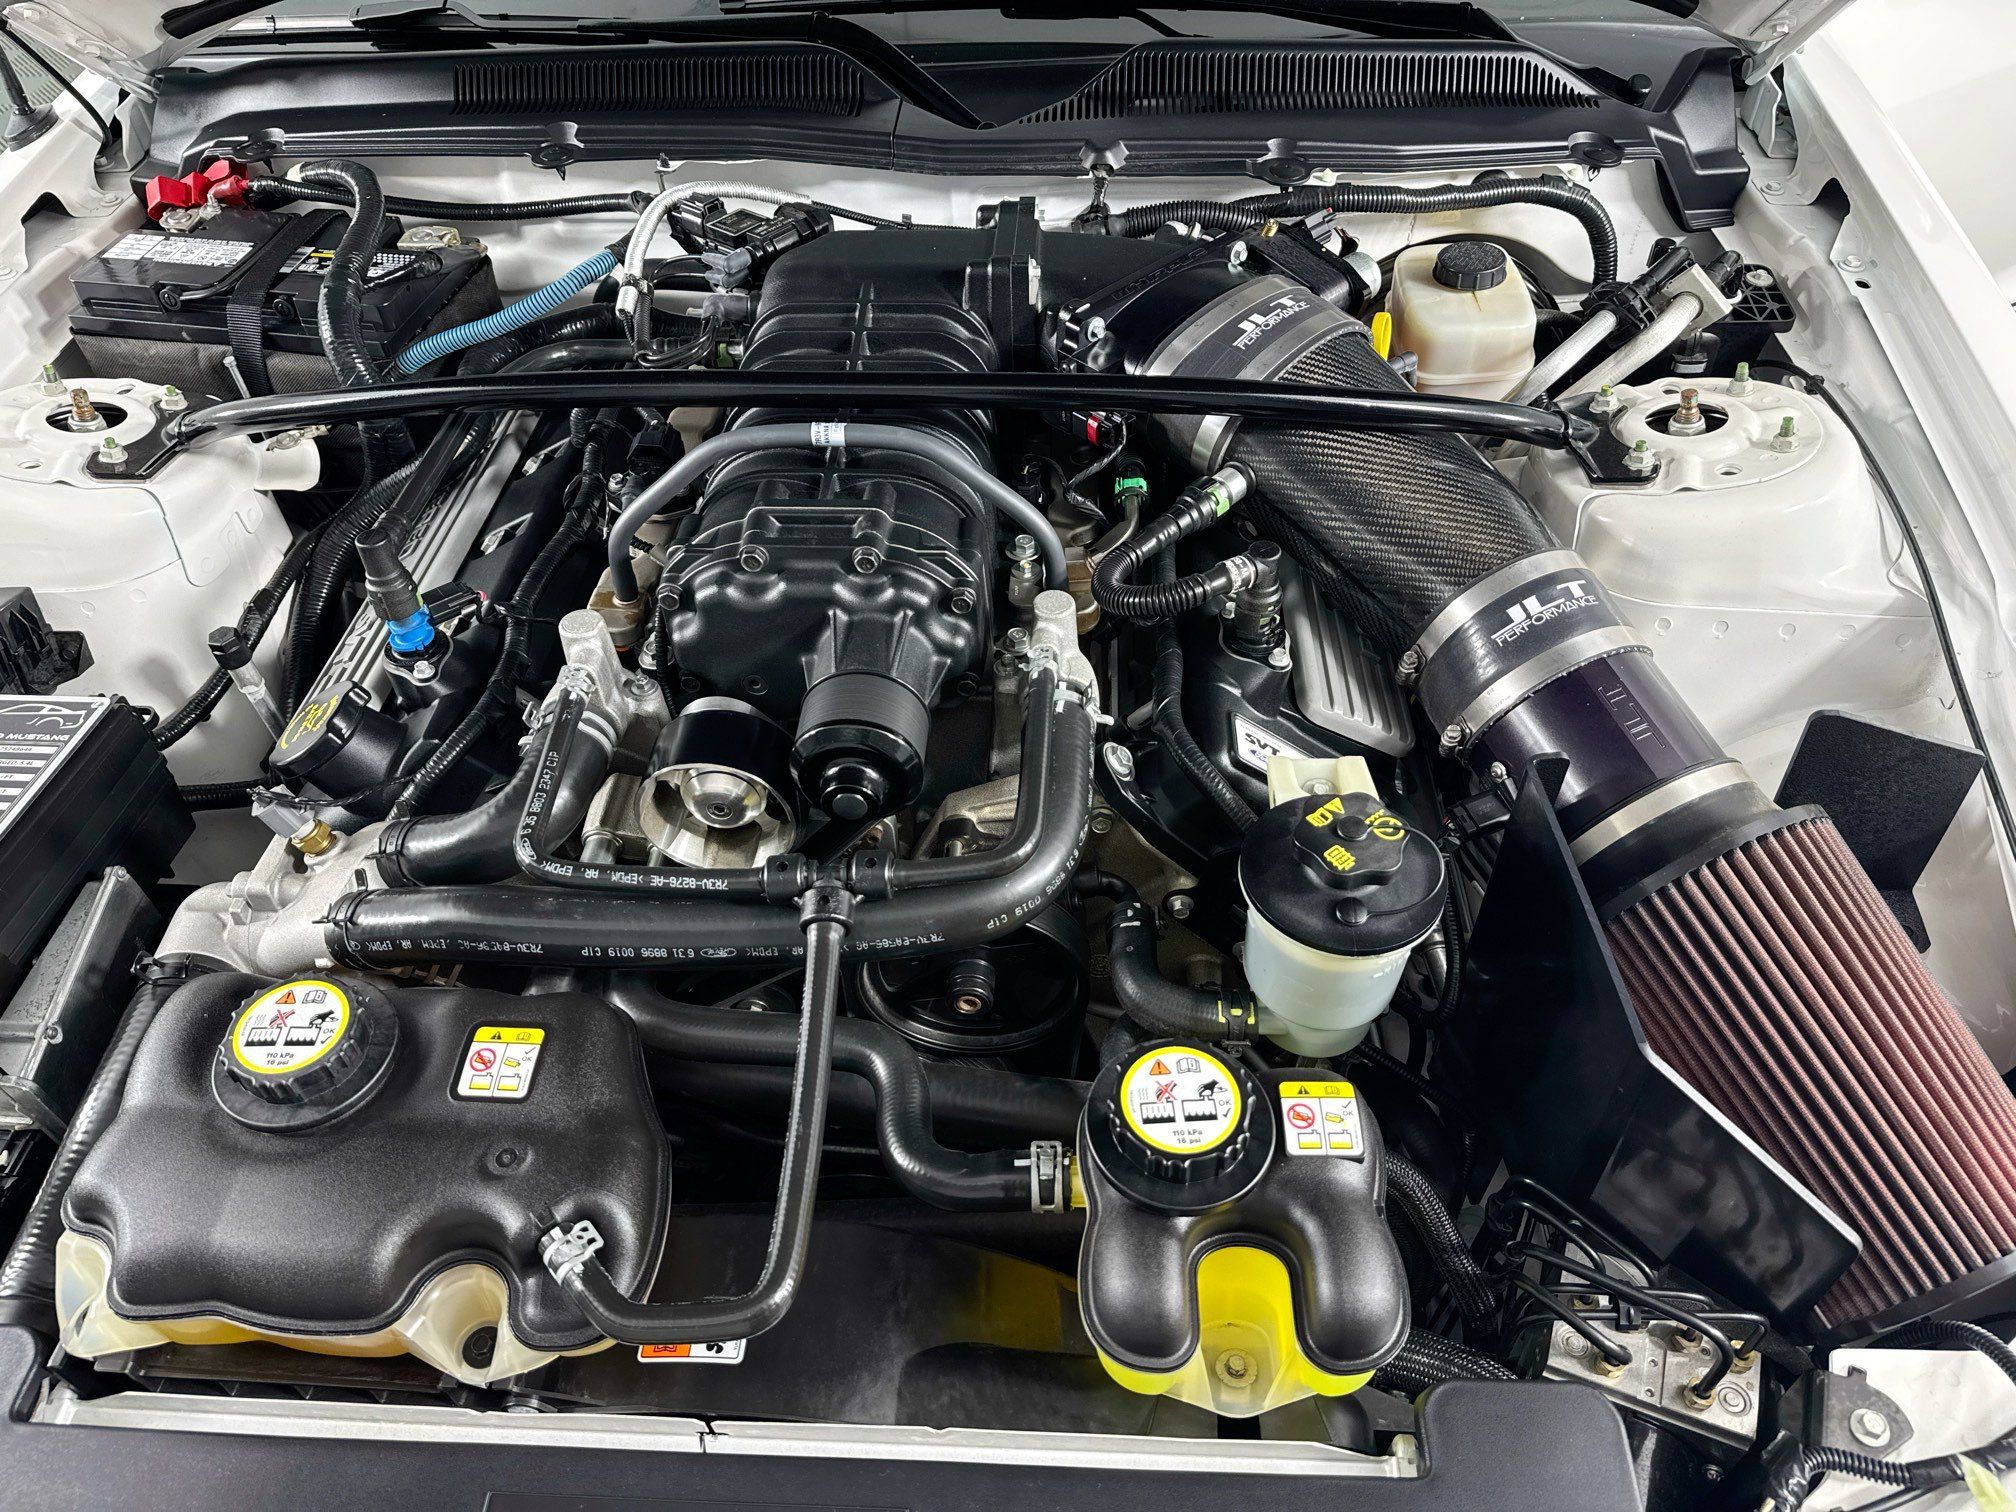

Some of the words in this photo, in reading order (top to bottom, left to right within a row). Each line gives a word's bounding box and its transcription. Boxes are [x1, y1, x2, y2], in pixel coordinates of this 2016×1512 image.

[1232, 294, 1296, 346] JLT
[1237, 301, 1310, 350] PERFORMANCE
[1491, 580, 1586, 640] JLT
[1496, 595, 1599, 647] PERFORMANCE
[5, 733, 71, 741] MUSTANG
[1245, 732, 1280, 756] SVT
[523, 815, 537, 826] 35
[650, 875, 729, 890] 7R3V-8276-AE
[608, 947, 635, 957] 0019
[641, 948, 668, 958] 8896
[1187, 1128, 1203, 1136] kPa
[1189, 1137, 1202, 1145] psi
